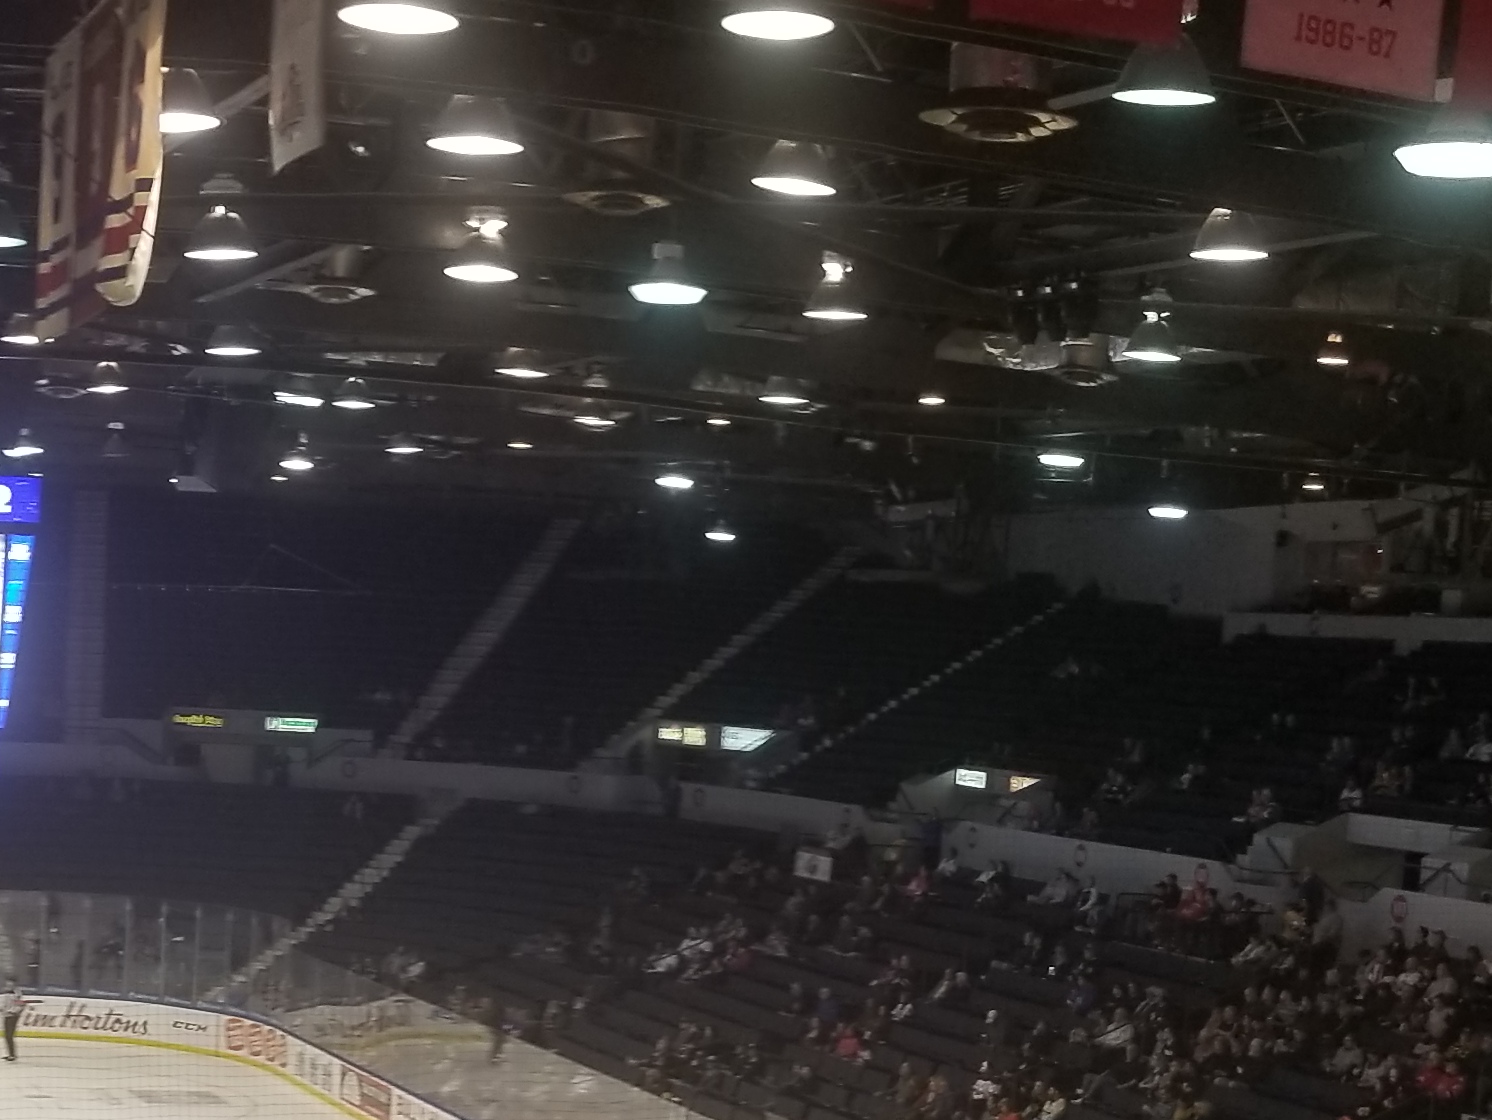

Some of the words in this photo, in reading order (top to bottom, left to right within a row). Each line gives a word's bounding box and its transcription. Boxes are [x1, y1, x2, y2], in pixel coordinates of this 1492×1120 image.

[1294, 12, 1399, 59] 1986-87
[59, 1001, 150, 1037] Hortons
[172, 1020, 207, 1032] CCM
